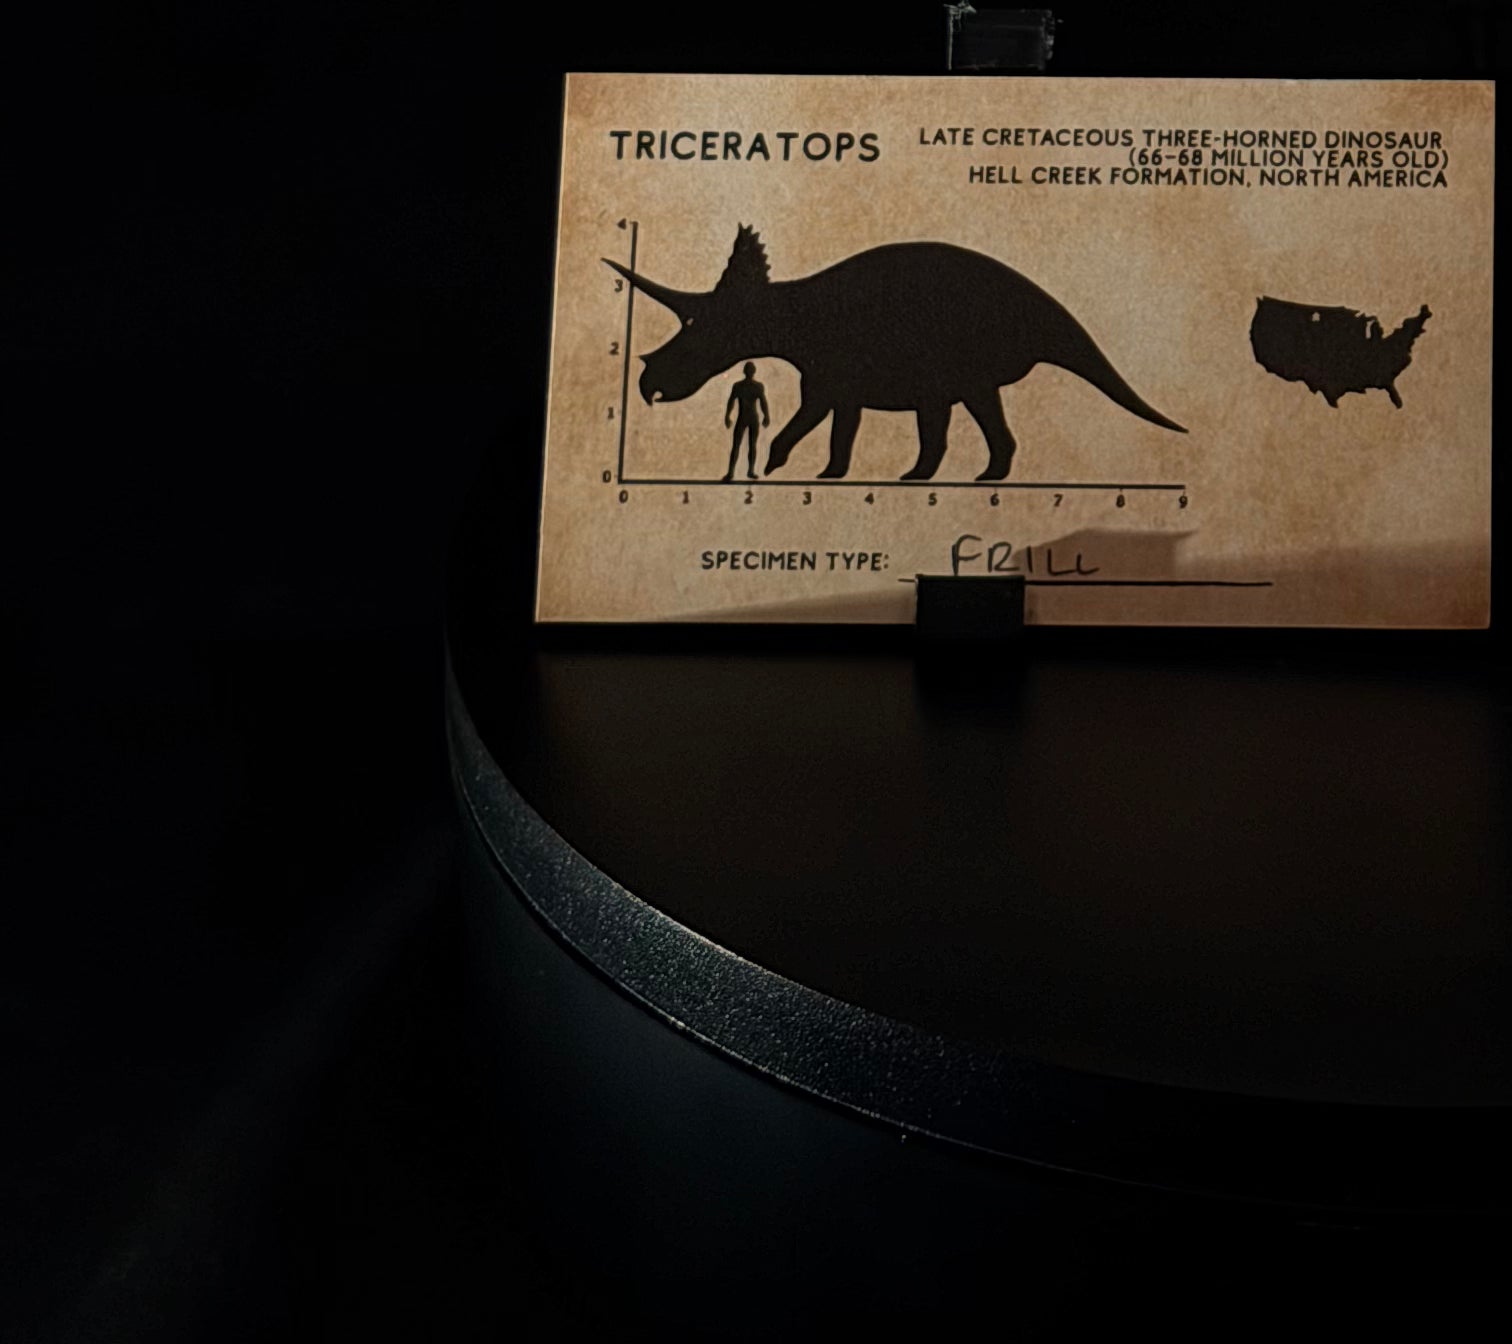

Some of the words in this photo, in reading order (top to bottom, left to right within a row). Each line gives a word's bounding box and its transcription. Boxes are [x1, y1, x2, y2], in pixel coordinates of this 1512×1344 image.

[609, 130, 880, 163] TRICERATOPS
[919, 127, 975, 146] LATE
[982, 128, 1134, 147] CRETACEOUS
[1142, 129, 1317, 148] THREE-HORNED
[1324, 130, 1442, 149] DINOSAUR
[1128, 147, 1202, 167] (66-68
[1211, 149, 1304, 167] MILLION
[1312, 150, 1384, 168] YEARS
[1391, 150, 1449, 170] OLD)
[968, 165, 1023, 184] HELL
[1030, 166, 1102, 185] CREEK
[1110, 167, 1252, 188] FORMATION,
[1259, 169, 1340, 187] NORTH
[1347, 169, 1448, 187] AMERICA
[614, 279, 624, 292] 3
[609, 341, 619, 355] 2
[607, 407, 615, 419] 1
[602, 470, 612, 483] 0
[618, 490, 629, 504] 0
[682, 490, 690, 504] 1
[743, 490, 754, 504] 2
[802, 491, 812, 505] 3
[864, 491, 875, 505] 4
[928, 493, 938, 506] 5
[990, 493, 1000, 507] 6
[1053, 493, 1063, 507] 7
[1116, 494, 1126, 508] 8
[1178, 495, 1189, 509] 9
[701, 550, 817, 571] SPECIMEN
[825, 552, 890, 572] TYPE:
[951, 534, 1100, 576] FRILL
